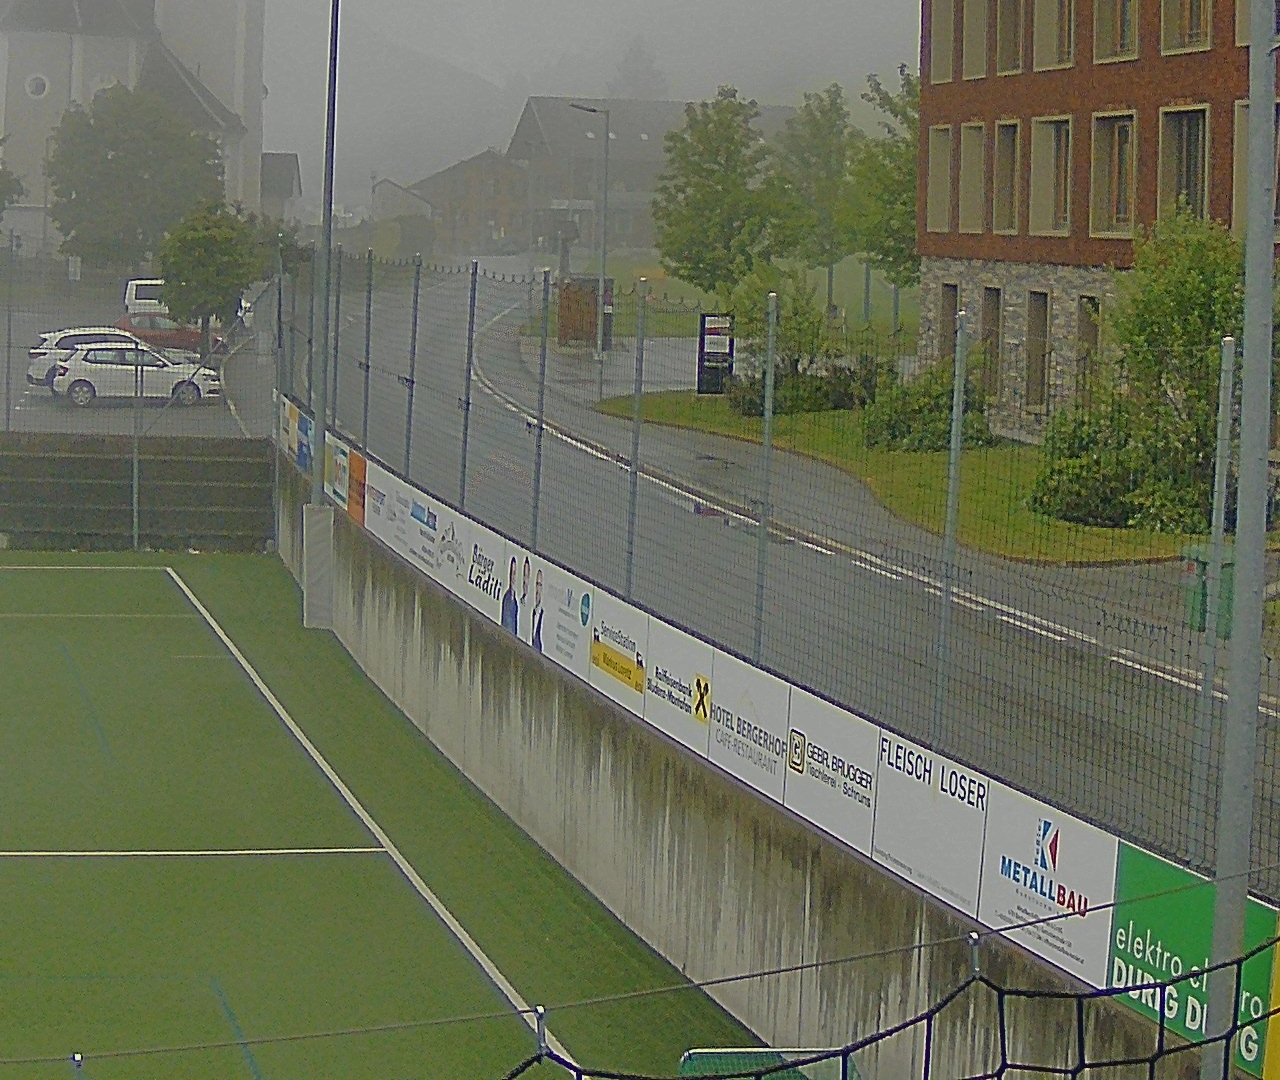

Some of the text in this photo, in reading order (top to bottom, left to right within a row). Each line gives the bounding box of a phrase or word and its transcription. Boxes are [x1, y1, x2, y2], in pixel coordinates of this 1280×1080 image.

[711, 702, 788, 760] HOTEL BERGERHOF
[806, 741, 873, 792] GEBR. BRUGGER
[880, 736, 986, 812] FLEISCH LOSER
[1000, 855, 1089, 919] METALLBAU
[1116, 920, 1182, 976] elektro
